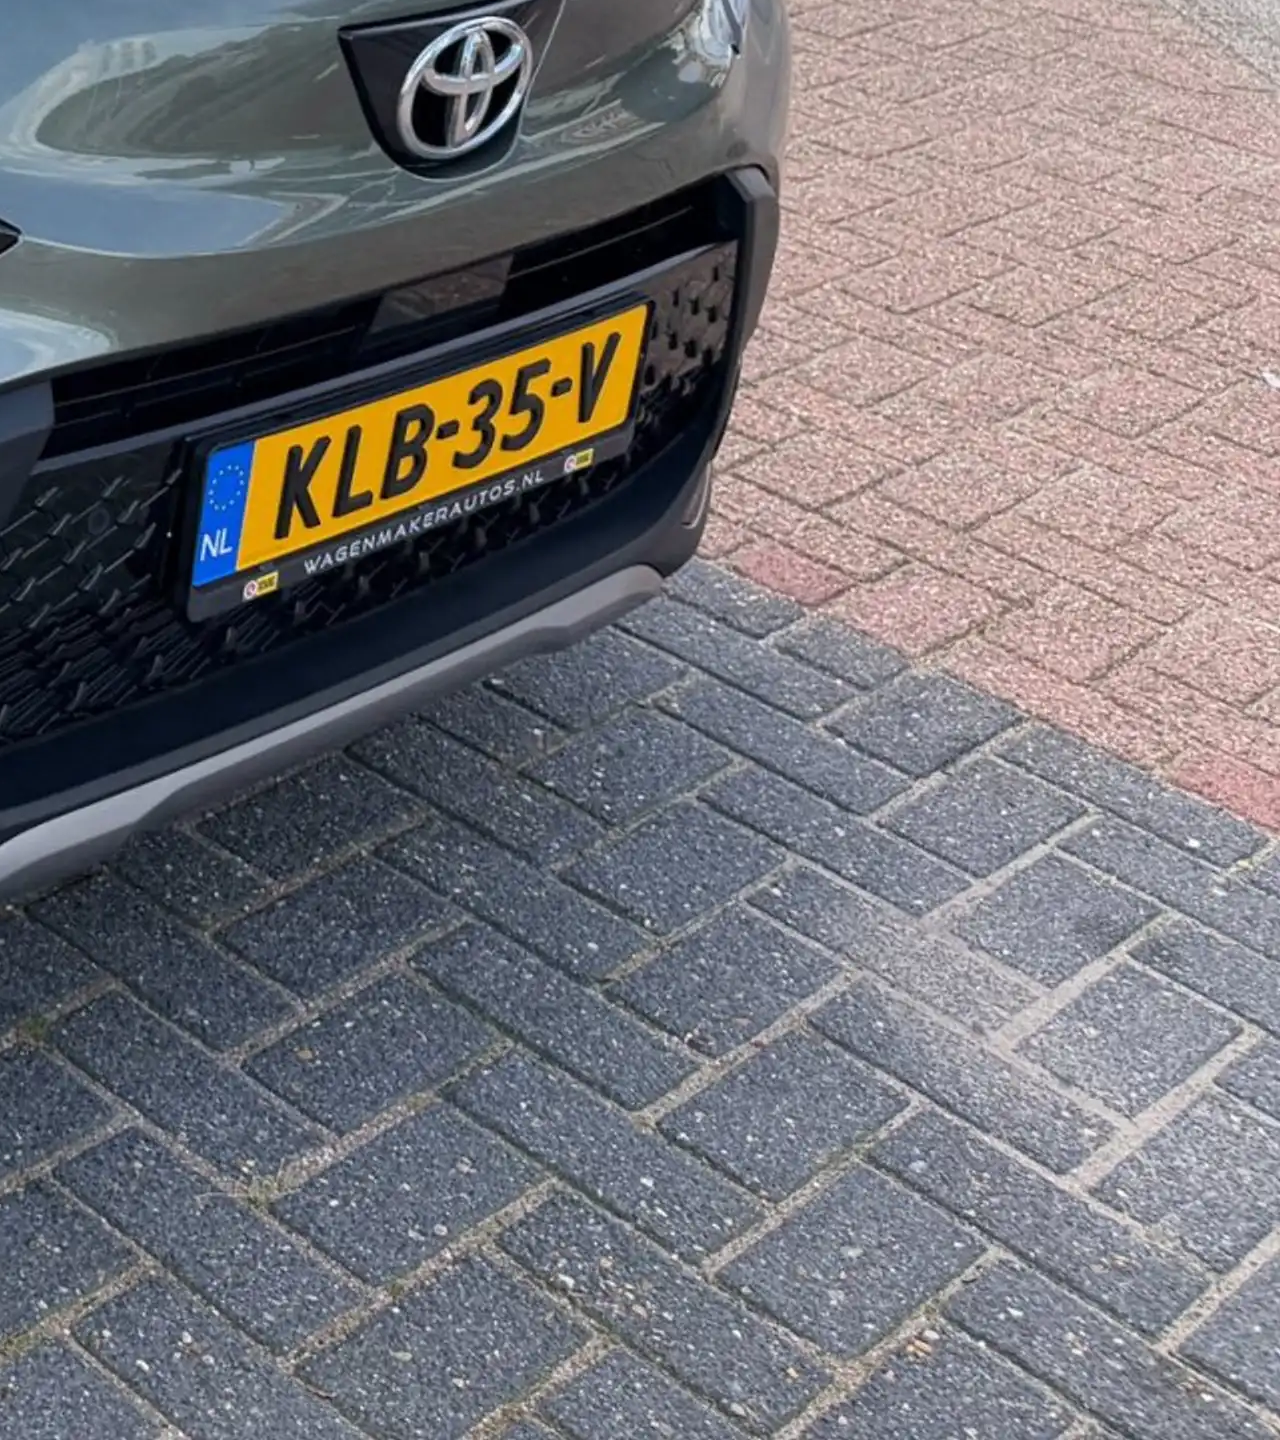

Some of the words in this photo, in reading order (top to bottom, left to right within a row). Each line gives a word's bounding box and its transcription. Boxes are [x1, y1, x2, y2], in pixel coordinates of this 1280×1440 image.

[274, 332, 621, 540] KLB-35-V
[200, 527, 233, 562] NL
[303, 468, 545, 576] WAGENMAKERAUTOS.NL
